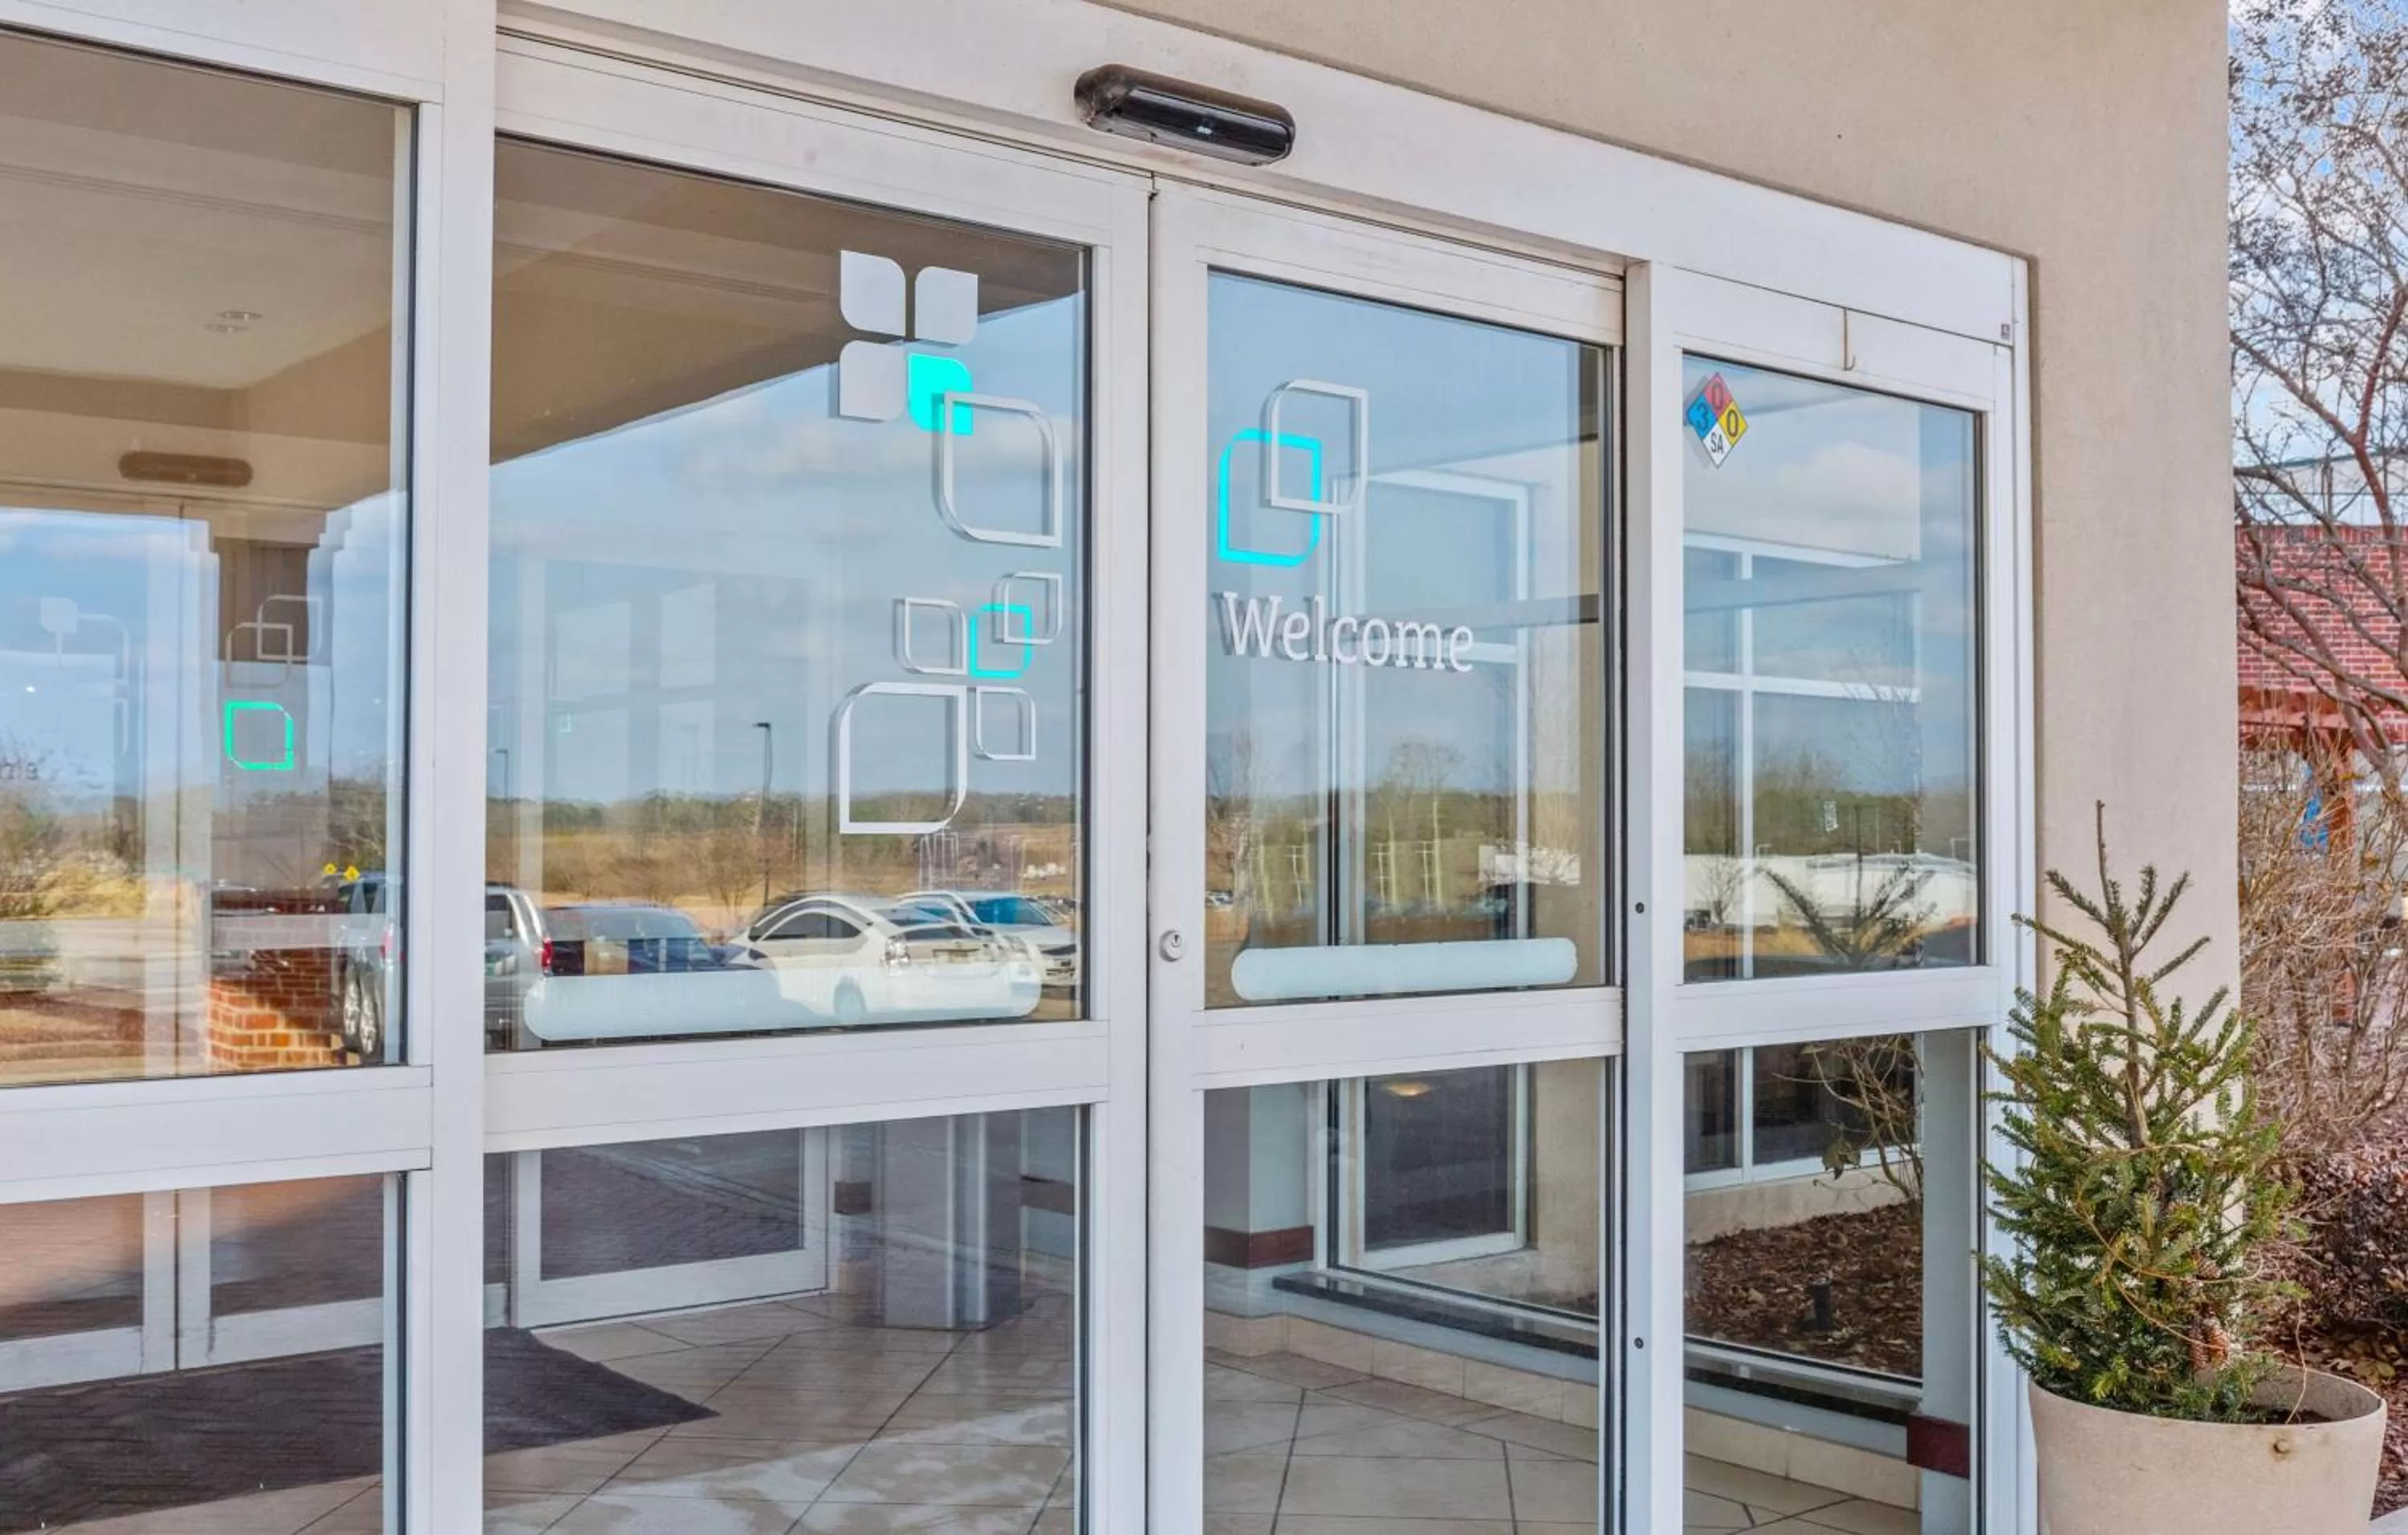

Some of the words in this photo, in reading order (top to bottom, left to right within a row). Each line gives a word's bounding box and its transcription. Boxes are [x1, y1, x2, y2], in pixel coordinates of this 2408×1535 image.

[1711, 383, 1723, 410] 0
[1696, 402, 1709, 432] 3
[1727, 409, 1739, 438] 0
[1710, 431, 1724, 454] SA
[1222, 590, 1474, 673] Welcome
